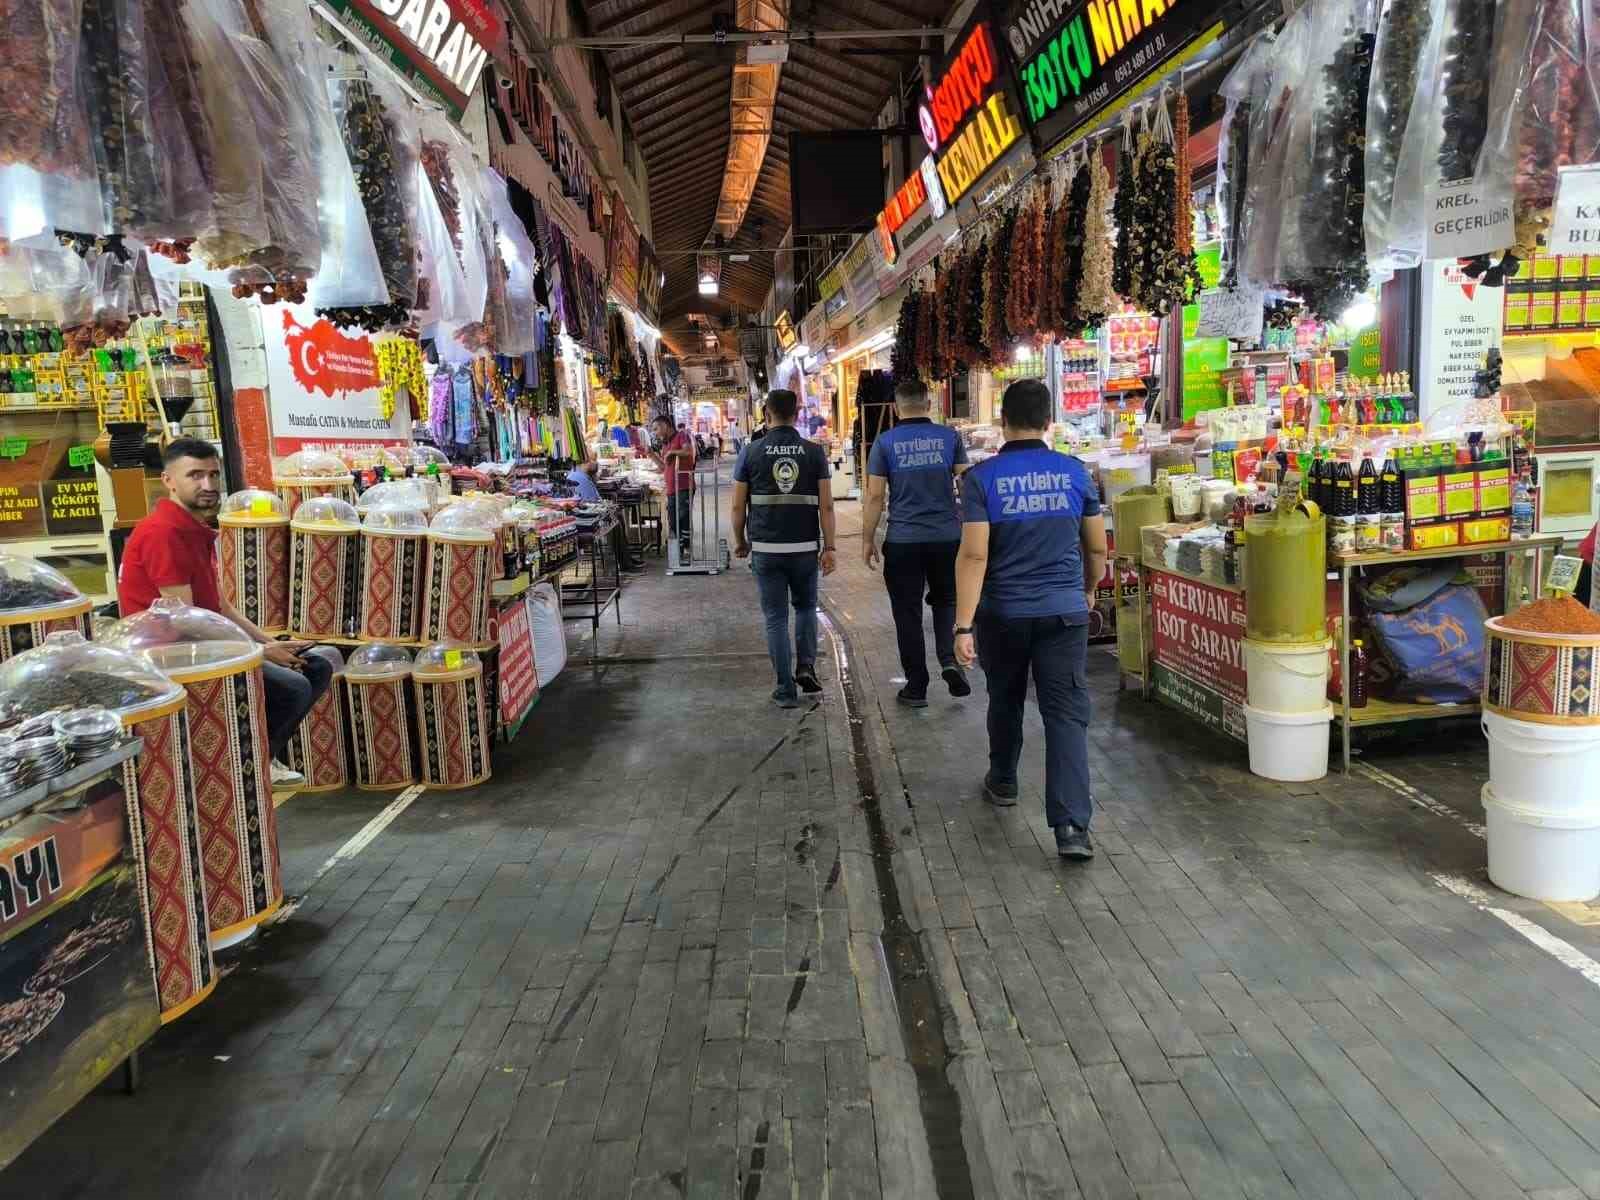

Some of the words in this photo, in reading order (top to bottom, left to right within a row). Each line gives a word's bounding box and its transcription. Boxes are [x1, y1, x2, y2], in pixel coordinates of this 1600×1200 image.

[370, 0, 488, 97] ARAYI
[937, 92, 1023, 205] KEMAL
[1435, 207, 1510, 235] GEÇERLİDİR
[1569, 229, 1600, 242] BU
[289, 413, 318, 426] Mustafa
[766, 445, 806, 456] ZABITA
[894, 438, 944, 454] EYYÜBİYE
[898, 452, 943, 468] ZABITA
[57, 484, 71, 493] EV
[997, 471, 1072, 494] EYYÜBİYE
[1002, 493, 1069, 514] ZABITA
[53, 509, 67, 518] AZ
[70, 507, 96, 518] ACILI
[1168, 579, 1230, 625] KERVAN
